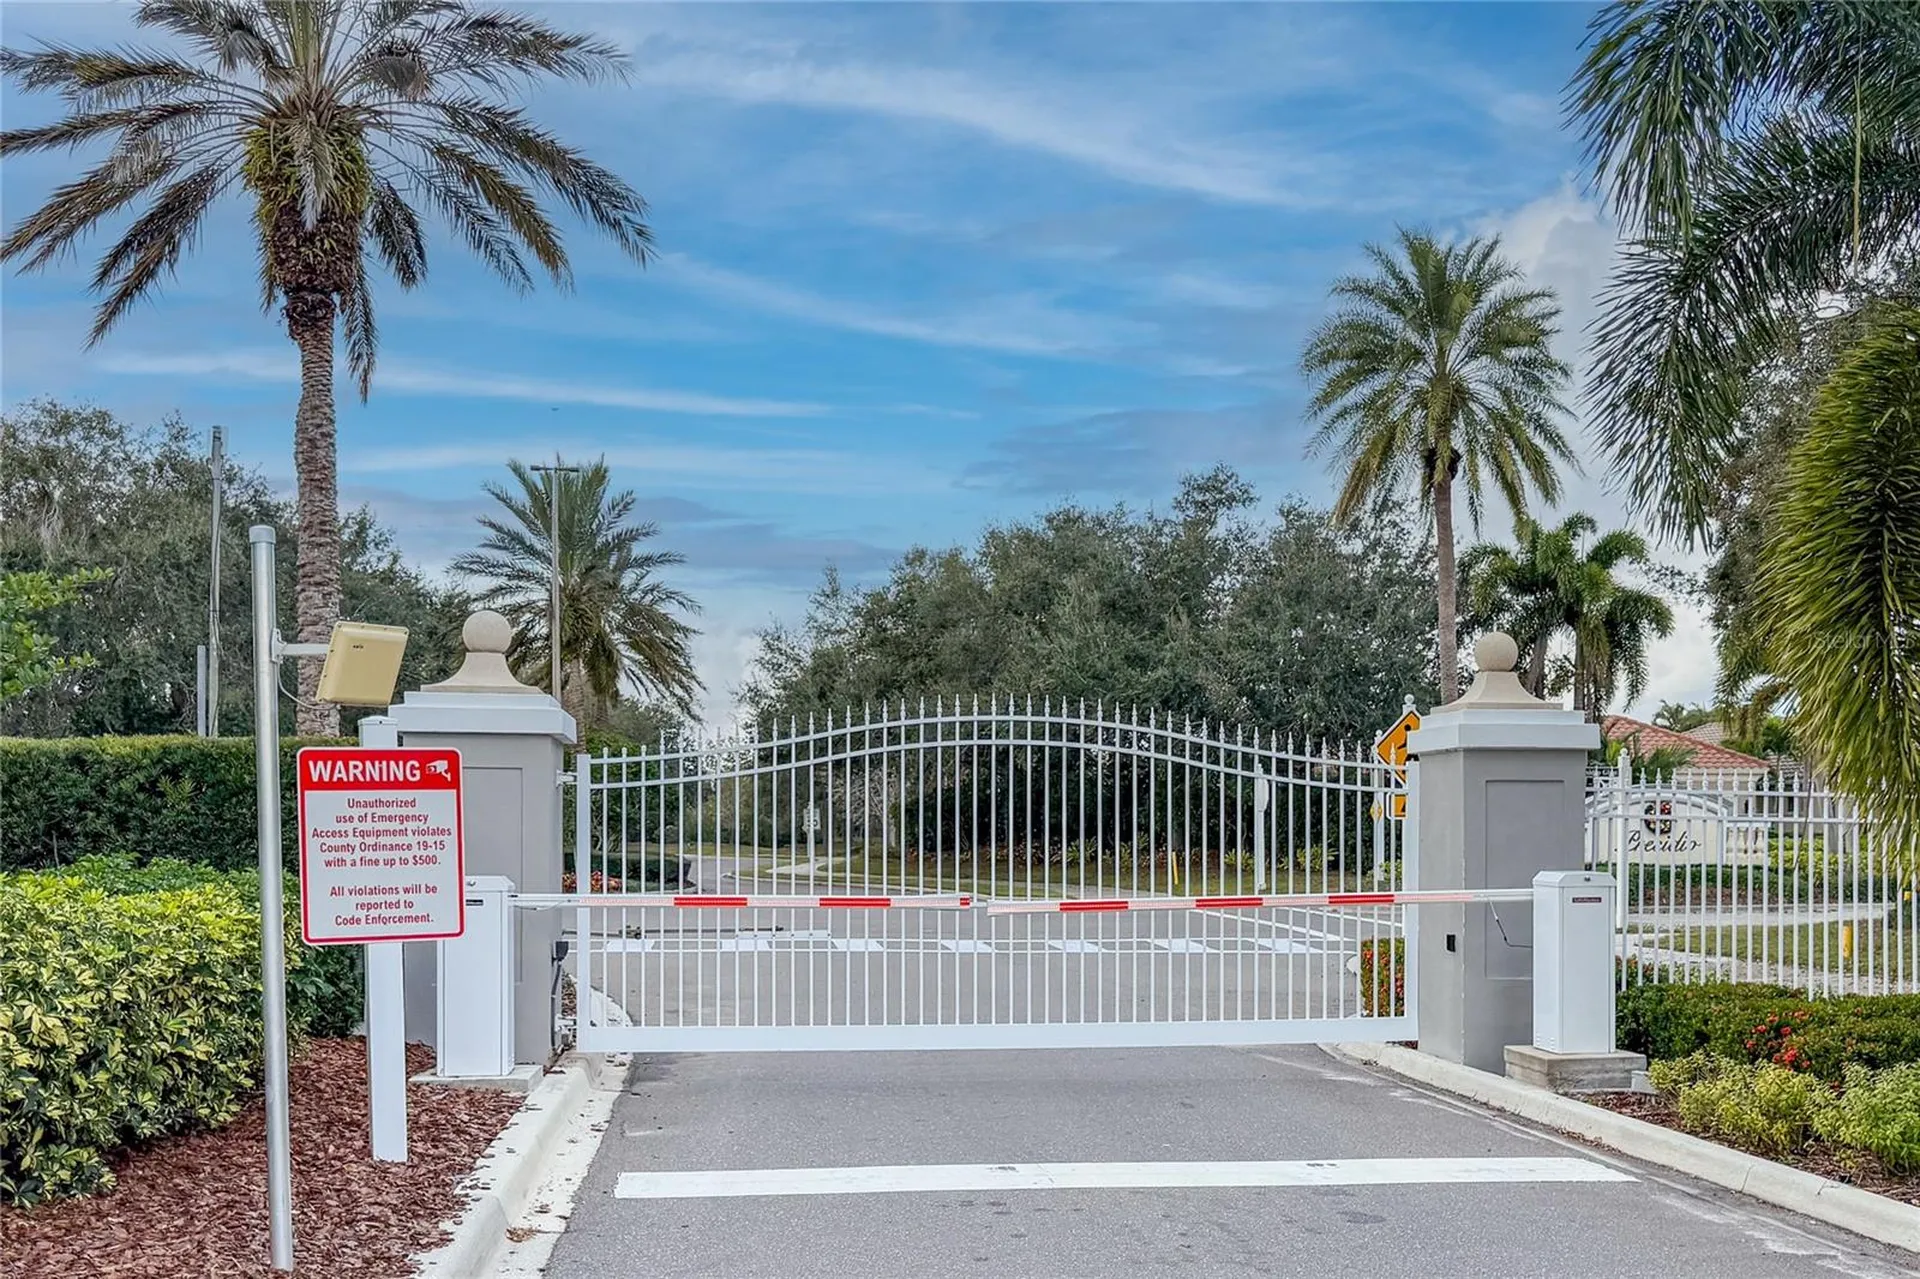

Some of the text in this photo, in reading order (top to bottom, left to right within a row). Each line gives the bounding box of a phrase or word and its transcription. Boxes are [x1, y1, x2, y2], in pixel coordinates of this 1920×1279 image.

[308, 760, 421, 783] WARNING
[347, 797, 416, 809] Unauthorized
[336, 813, 429, 825] use of Emergency
[312, 827, 452, 839] Access Equipment violates
[320, 840, 445, 855] County Ordinance 19-15
[324, 854, 441, 868] with a fine up to $500.
[330, 884, 438, 897] All violations will be
[356, 899, 414, 912] reported to
[335, 913, 433, 926] Code Enforcement.
